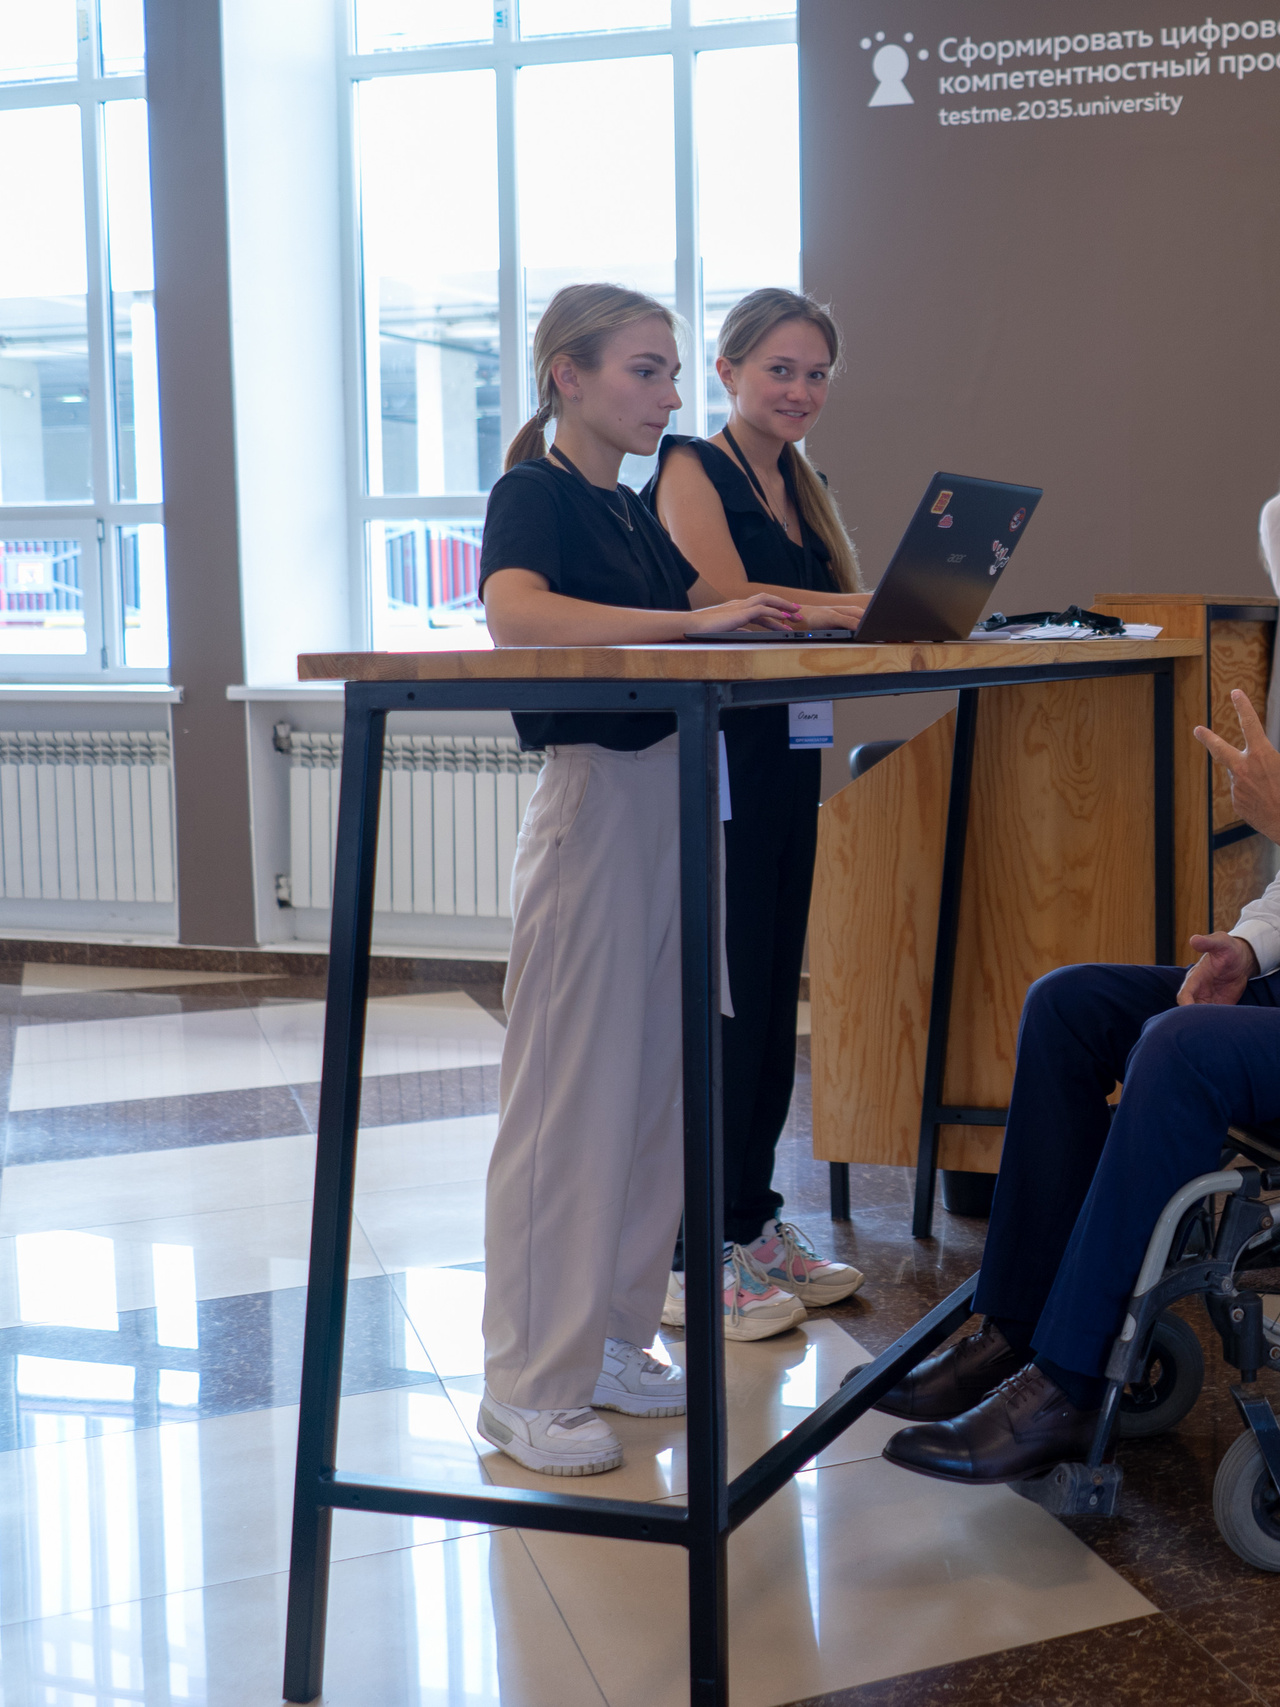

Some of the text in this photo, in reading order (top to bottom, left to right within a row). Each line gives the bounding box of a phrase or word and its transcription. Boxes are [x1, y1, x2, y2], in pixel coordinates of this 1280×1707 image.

[938, 30, 1154, 68] Сформировать
[938, 47, 1213, 95] компетентностный
[938, 91, 1183, 126] testme.2035.university
[946, 553, 967, 563] acer
